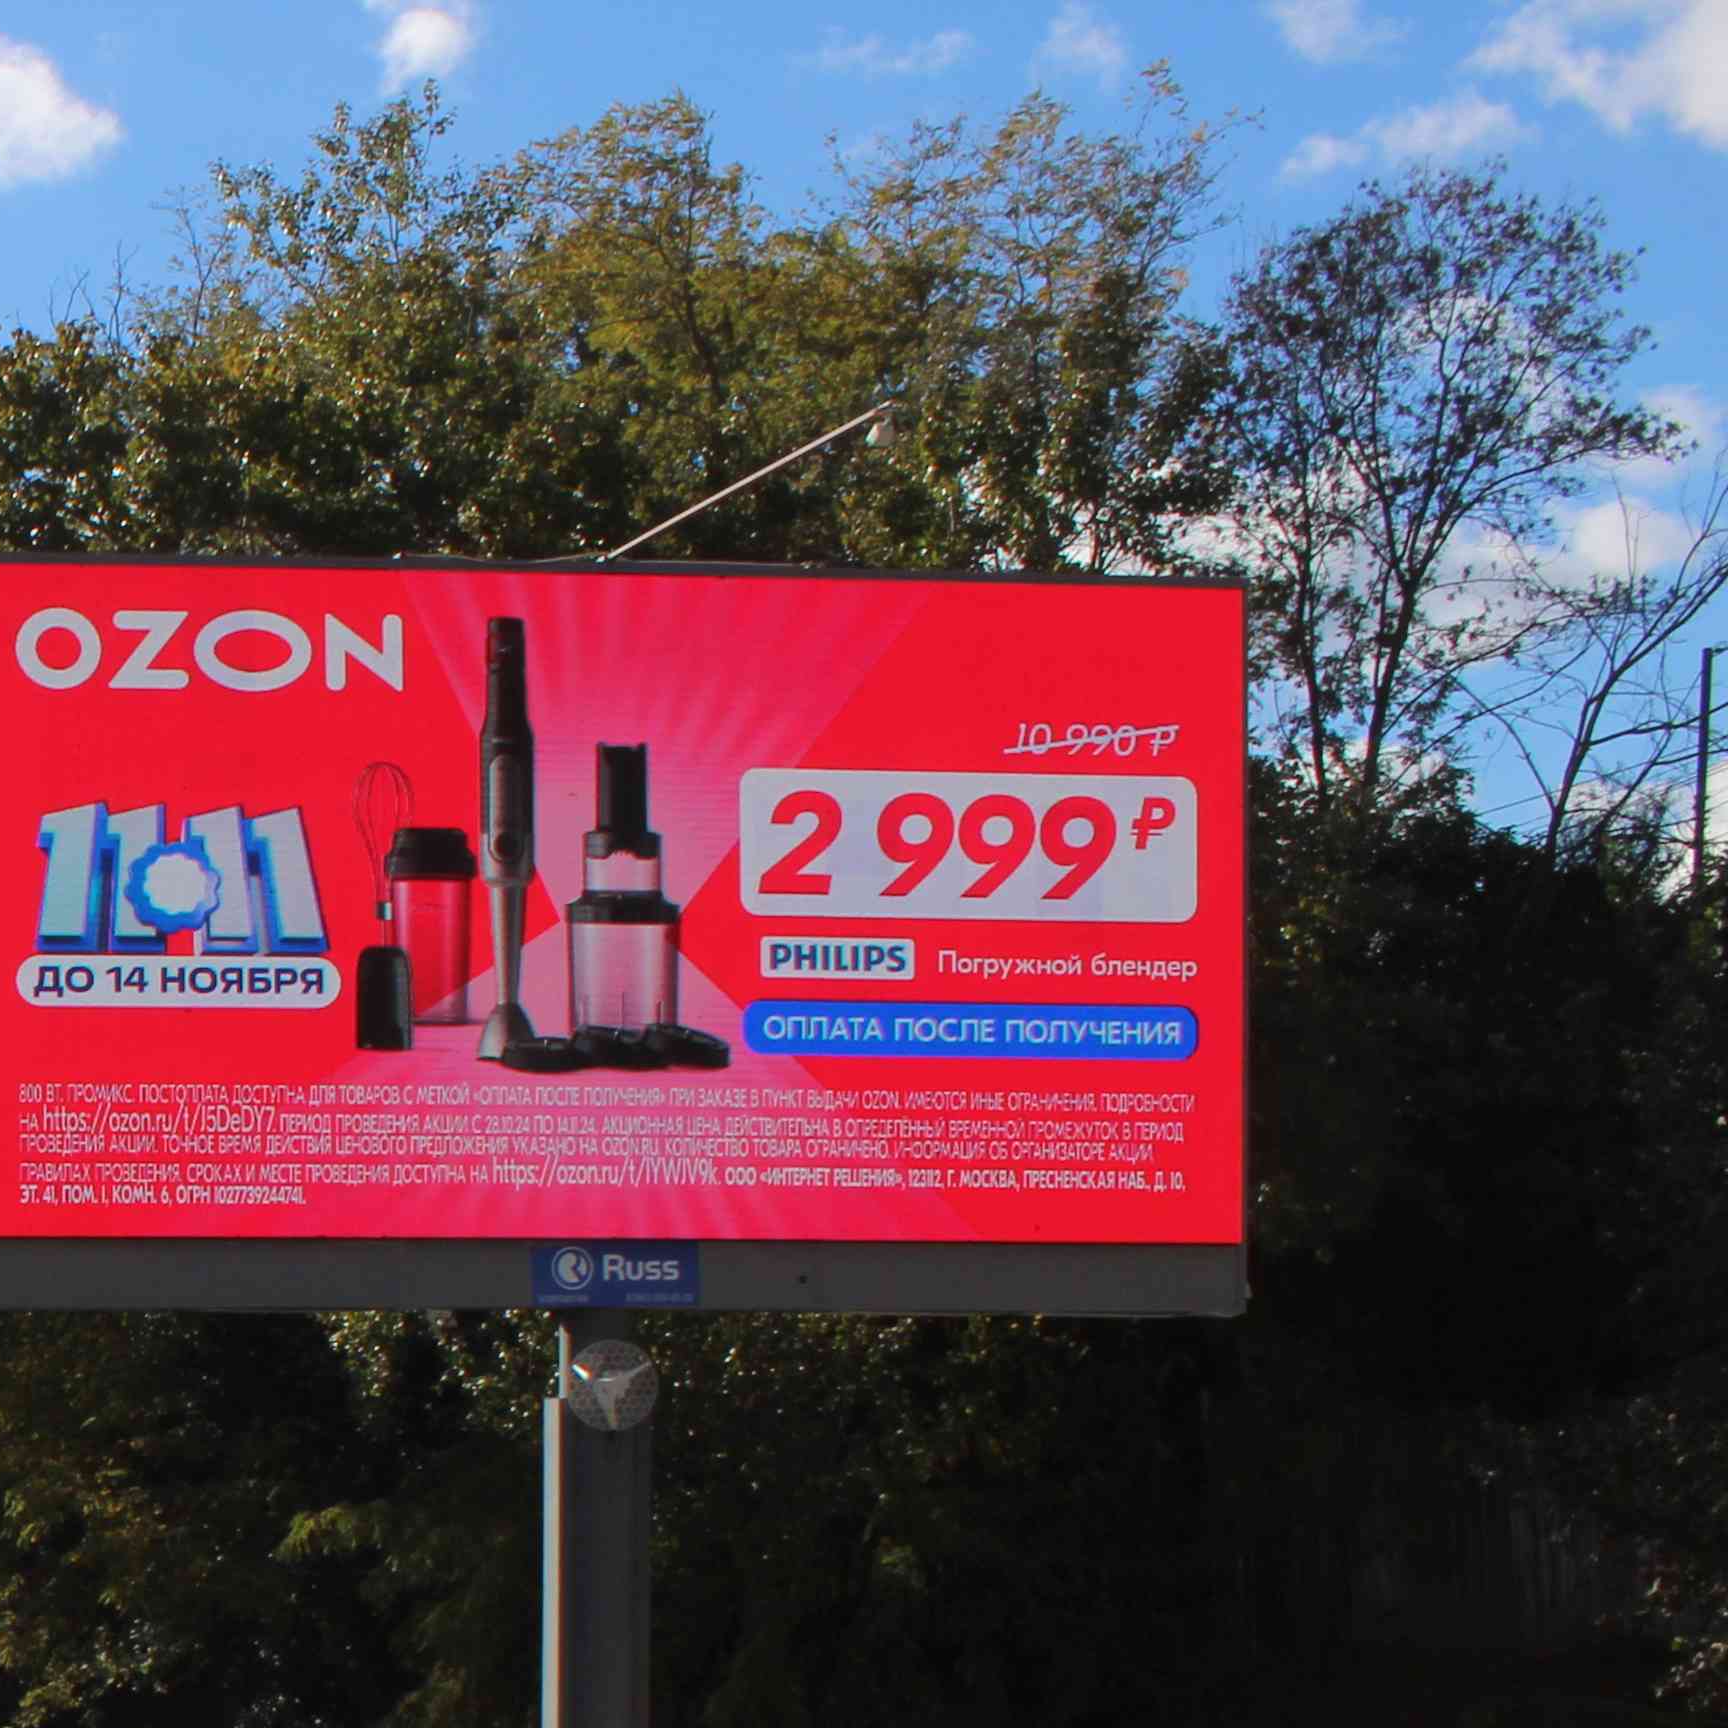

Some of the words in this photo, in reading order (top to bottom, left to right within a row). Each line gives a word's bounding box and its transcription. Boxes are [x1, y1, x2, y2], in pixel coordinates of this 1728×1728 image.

[15, 607, 404, 692] OZON
[1016, 723, 1052, 755] 10
[1066, 724, 1137, 757] 990
[757, 790, 843, 896] 2
[875, 791, 1117, 900] 999
[769, 942, 907, 973] PHILIPS
[937, 949, 1082, 983] Погружной
[1090, 952, 1198, 983] блендер
[34, 965, 95, 997] ДО
[105, 965, 150, 994] 14
[160, 966, 325, 995] НОЯБРЯ
[762, 1014, 883, 1043] ОПЛАТА
[892, 1016, 996, 1045] ПОСЛЕ
[1005, 1018, 1182, 1047] ПОЛУЧЕНИЯ
[19, 1083, 42, 1103] 800
[138, 1084, 228, 1104] ПОСТОПЛАТА
[309, 1085, 337, 1107] ДЛЯ
[339, 1085, 400, 1104] ТОВАРОВ
[403, 1086, 413, 1105] С
[416, 1083, 470, 1105] МЕТКОЙ
[535, 1087, 581, 1106] ПОСЛЕ
[669, 1088, 694, 1107] ПРИ
[697, 1088, 746, 1108] ЗАКАЗЕ
[750, 1089, 759, 1108] В
[762, 1089, 805, 1108] ПУНКТ
[19, 1113, 39, 1132] НА
[279, 1114, 331, 1135] ПЕРИОД
[335, 1114, 420, 1135] ПРОВЕДЕНИЯ
[472, 1115, 482, 1134] С
[533, 1116, 554, 1135] ПО
[601, 1117, 684, 1135] АКЦИОННАЯ
[687, 1117, 721, 1136] ЦЕНА
[833, 1119, 842, 1137] В
[1028, 1121, 1119, 1140] ПРОМЕЖУТОК
[1122, 1121, 1131, 1140] В
[1135, 1122, 1185, 1144] ПЕРИОД
[19, 1134, 105, 1156] ПРОВЕДЕНИЯ
[161, 1135, 215, 1154] ТОЧНОЕ
[218, 1135, 261, 1154] ВРЕМЯ
[265, 1135, 332, 1156] ДЕЙСТВИЯ
[335, 1135, 407, 1154] ЦЕНОВОГО
[410, 1136, 509, 1158] ПРЕДЛОЖЕНИЯ
[511, 1137, 576, 1156] УКАЗАНО
[579, 1137, 598, 1156] НА
[665, 1138, 750, 1157] КОЛИЧЕСТВО
[752, 1139, 802, 1157] ТОВАРА
[989, 1141, 1008, 1159] ОБ
[1011, 1142, 1105, 1160] ОРГАНИЗАТОРЕ
[19, 1163, 90, 1182] ПРАВИЛАХ
[186, 1164, 242, 1183] СРОКАХ
[245, 1164, 255, 1183] И
[259, 1164, 302, 1183] МЕСТЕ
[305, 1164, 389, 1186] ПРОВЕДЕНИЯ
[393, 1164, 466, 1187] ДОСТУПНА
[469, 1165, 489, 1184] НА
[724, 1167, 757, 1186] ООО
[1023, 1170, 1115, 1189] ПРЕСНЕНСКАЯ
[175, 1186, 211, 1205] ОГРН
[601, 1253, 681, 1282] Russ
